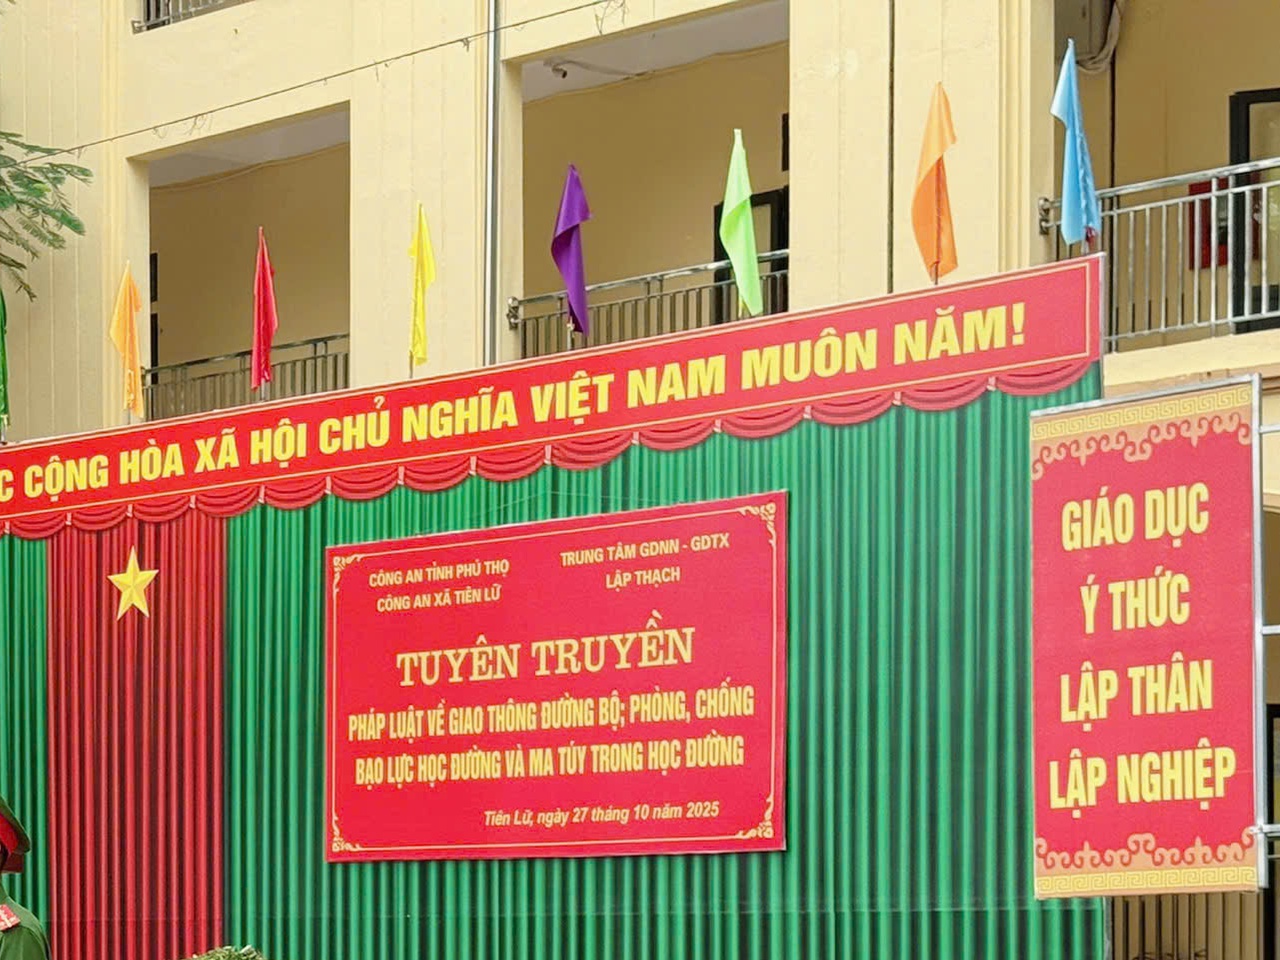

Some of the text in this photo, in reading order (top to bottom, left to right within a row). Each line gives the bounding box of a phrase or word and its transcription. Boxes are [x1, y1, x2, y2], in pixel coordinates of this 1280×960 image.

[24, 455, 109, 501] CỘNG
[119, 438, 185, 484] HÒA
[194, 427, 239, 473] XÃ
[250, 418, 307, 468] HỘI
[319, 395, 390, 454] CHỦ
[402, 386, 518, 443] NGHĨA
[529, 370, 614, 425] VIỆT
[626, 354, 726, 409] NAM
[740, 326, 877, 390] MUÔN
[893, 302, 1026, 366] NĂM!
[560, 548, 604, 566] TRUNG
[607, 542, 636, 561] TÂM
[639, 538, 679, 557] GDNN
[690, 533, 730, 551] GDTX
[1061, 482, 1210, 552] GIÁO DỤC
[369, 559, 509, 587] CÔNG AN TỈNH PHÚ THỌ
[377, 583, 502, 612] CÔNG AN XÃ TIÊN LỮ
[605, 566, 681, 592] LẬP THẠCH
[1079, 565, 1191, 635] Ý THỨC
[396, 609, 695, 687] TUYÊN TRUYỀN
[348, 676, 754, 744] PHÁP LUẬT VỀ GIAO THÔNG ĐƯỜNG BỘ; PHÒNG, CHỐNG
[1060, 651, 1213, 732] LẬP THÂN
[355, 729, 744, 790] BẠO LỰC HỌC ĐƯỜNG VÀ MA TÚY TRONG HỌC ĐƯỜNG
[1048, 737, 1237, 818] LẬP NGHIỆP
[484, 810, 510, 826] Tiên
[537, 809, 569, 828] ngày
[572, 807, 589, 823] 27
[591, 806, 629, 824] tháng
[633, 804, 650, 820] 10
[652, 804, 682, 819] năm
[686, 800, 719, 818] 2025
